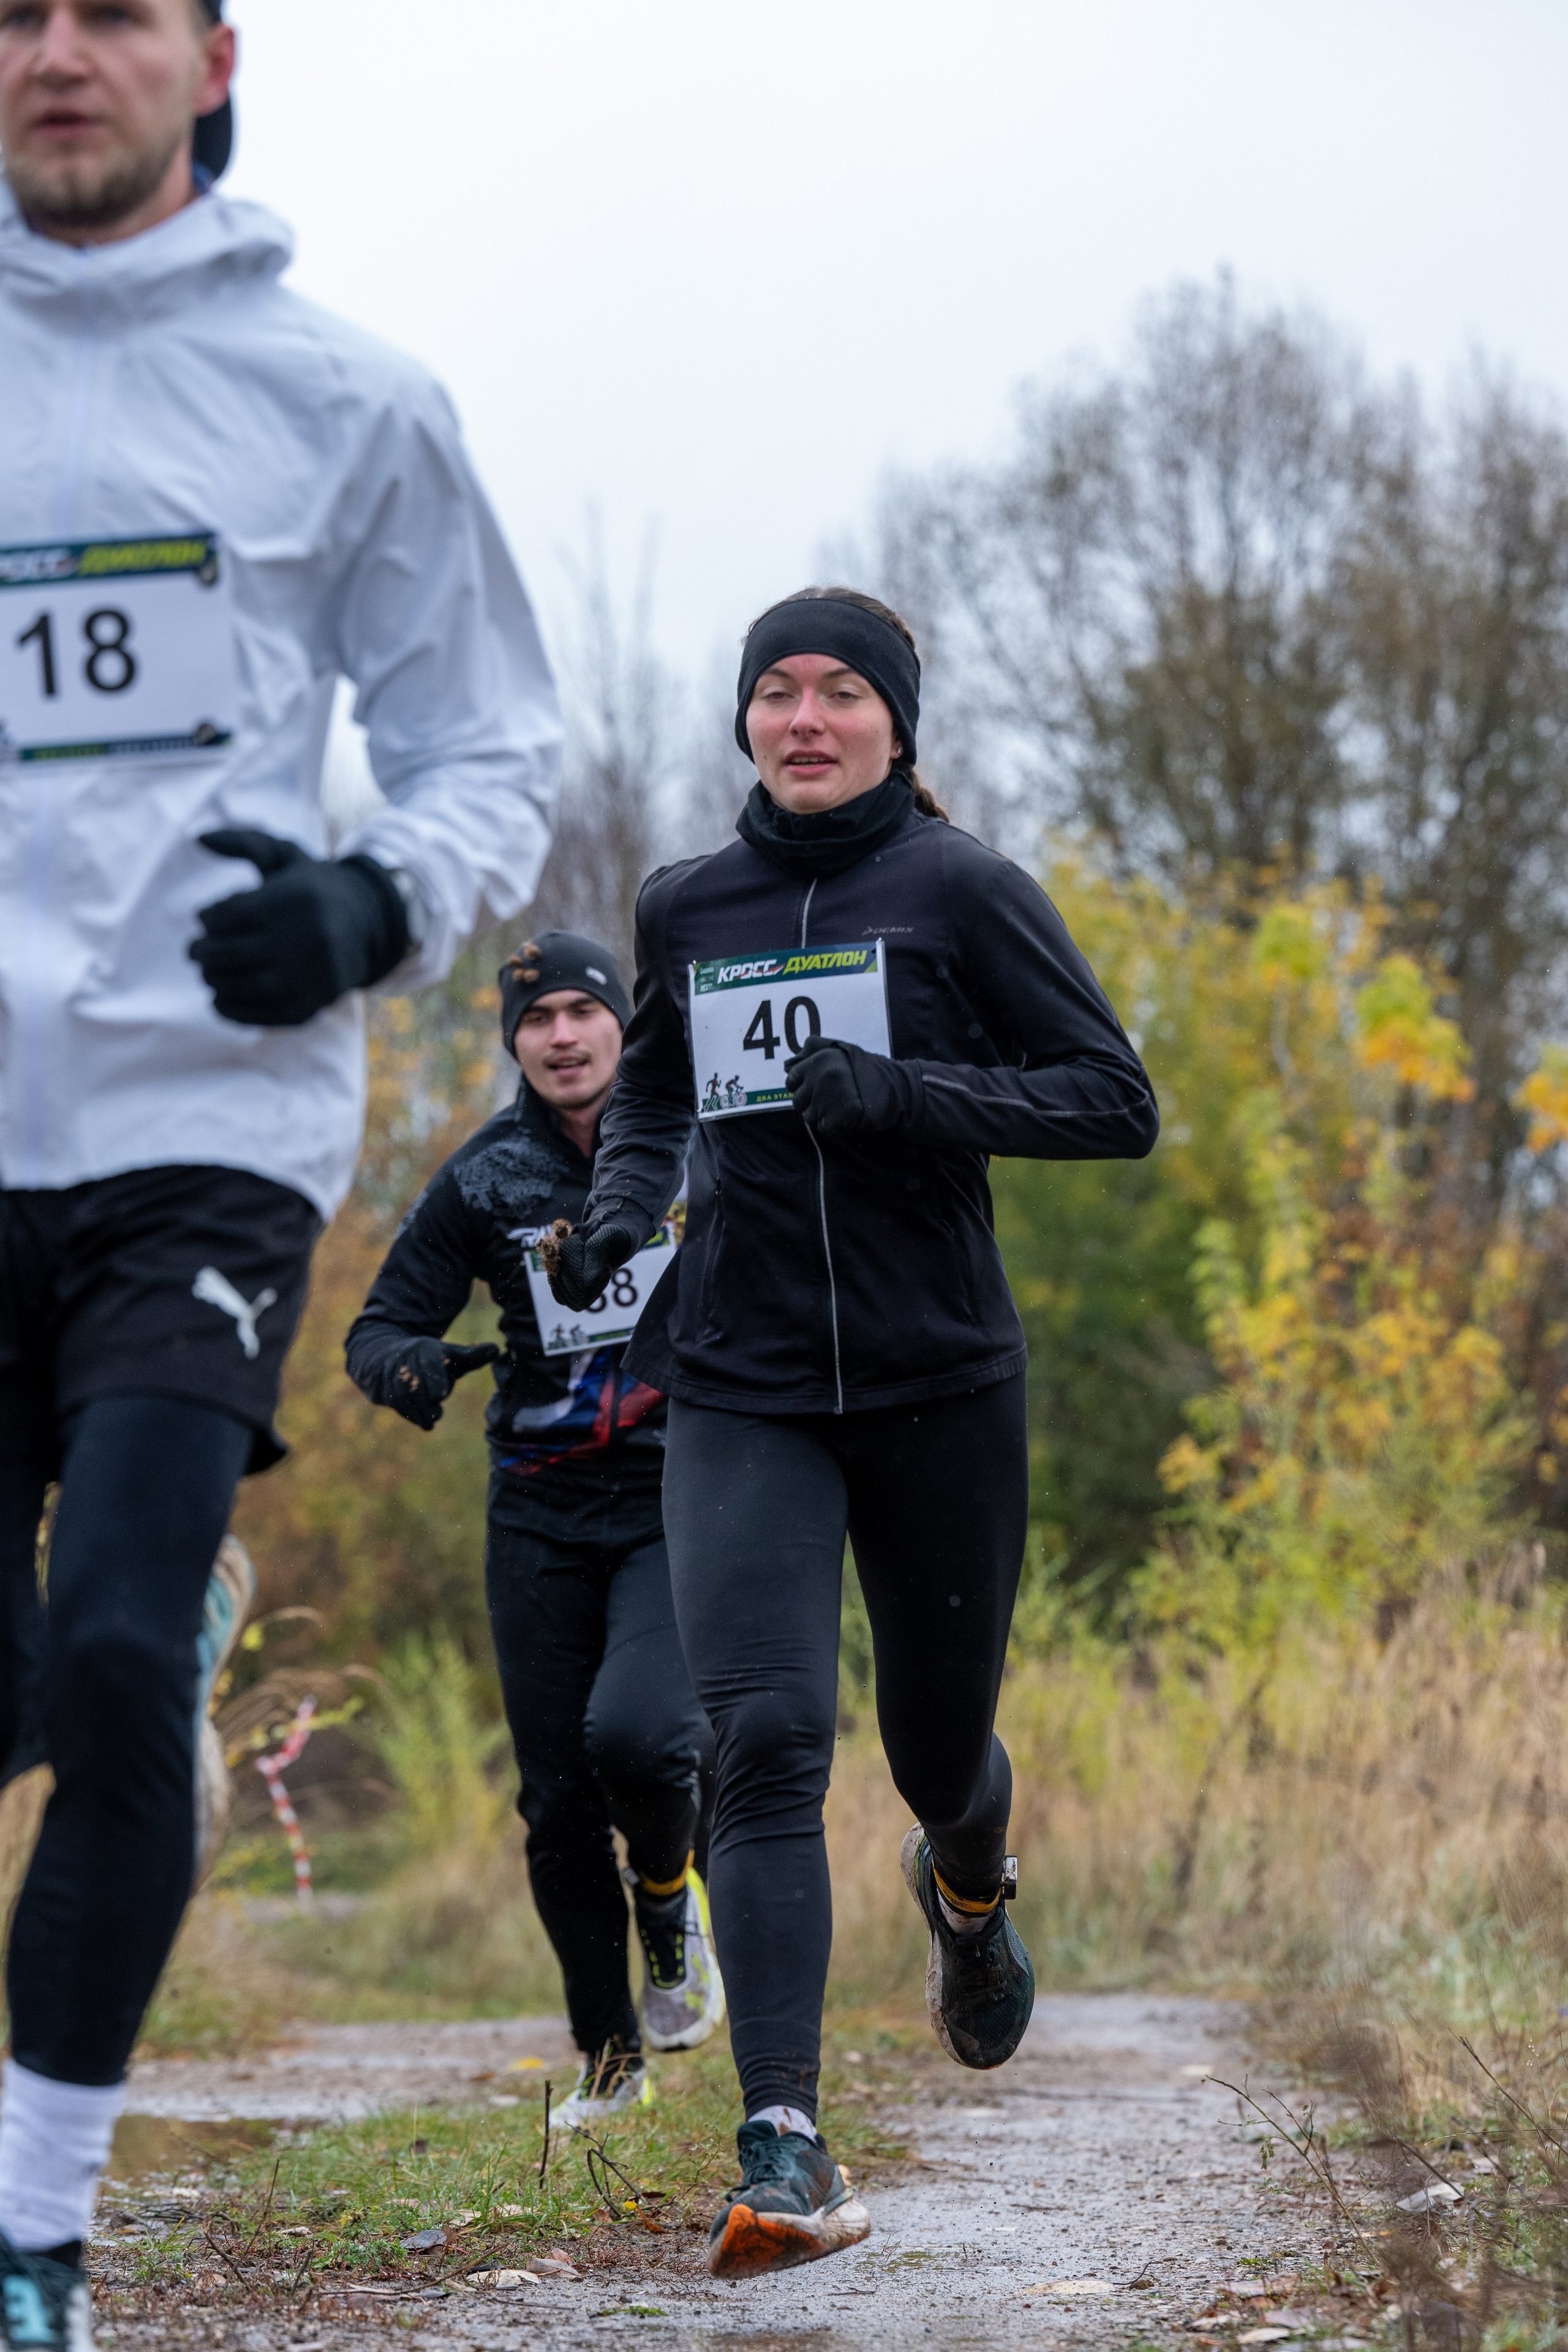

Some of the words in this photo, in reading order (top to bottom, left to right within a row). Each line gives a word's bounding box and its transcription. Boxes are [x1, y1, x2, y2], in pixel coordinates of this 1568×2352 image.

[17, 608, 135, 698] 18
[717, 959, 783, 984] КРОСС
[782, 950, 867, 976] ДУАТЛОН
[742, 996, 821, 1060] 40
[586, 1267, 638, 1313] 8
